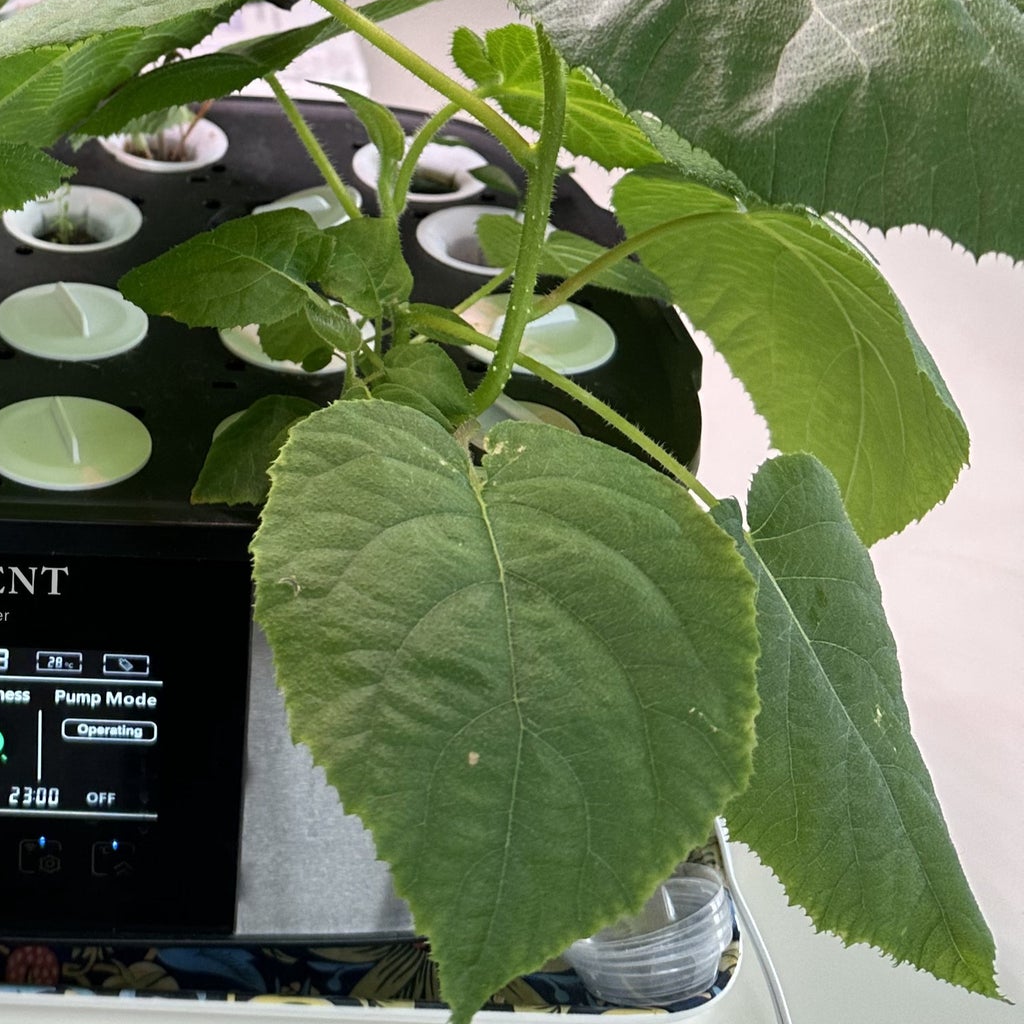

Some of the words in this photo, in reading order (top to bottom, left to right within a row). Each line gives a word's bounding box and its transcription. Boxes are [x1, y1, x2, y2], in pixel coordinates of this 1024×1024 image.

[54, 689, 102, 708] Pump
[105, 691, 158, 708] Mode
[77, 723, 144, 739] Operating
[8, 787, 60, 807] 23:00
[86, 791, 117, 807] OFF
